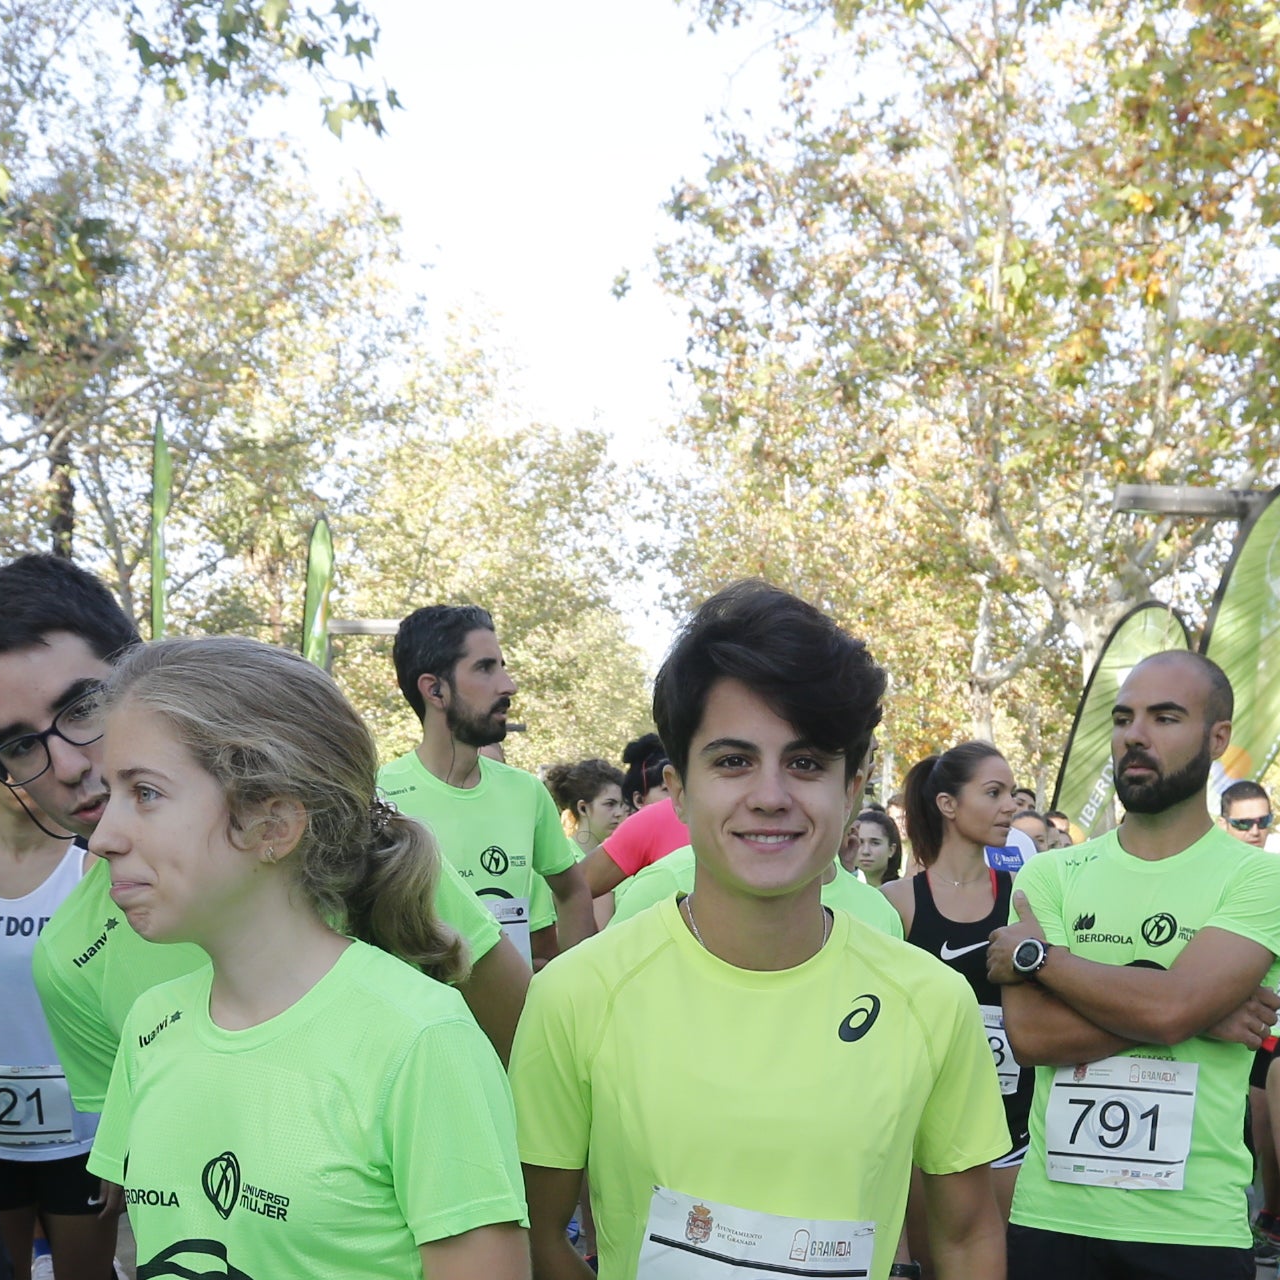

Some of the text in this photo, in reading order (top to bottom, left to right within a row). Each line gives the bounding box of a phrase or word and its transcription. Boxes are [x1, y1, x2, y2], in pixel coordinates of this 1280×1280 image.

[6, 916, 33, 937] DO
[1076, 934, 1134, 945] IBERDROLA
[1068, 1098, 1160, 1151] 791
[241, 1181, 290, 1208] UNIVERSO
[239, 1194, 288, 1222] MUJER
[715, 1222, 763, 1240] AYUNTAMIENTO
[726, 1233, 757, 1247] GRANADA
[810, 1240, 852, 1257] GRANADA
